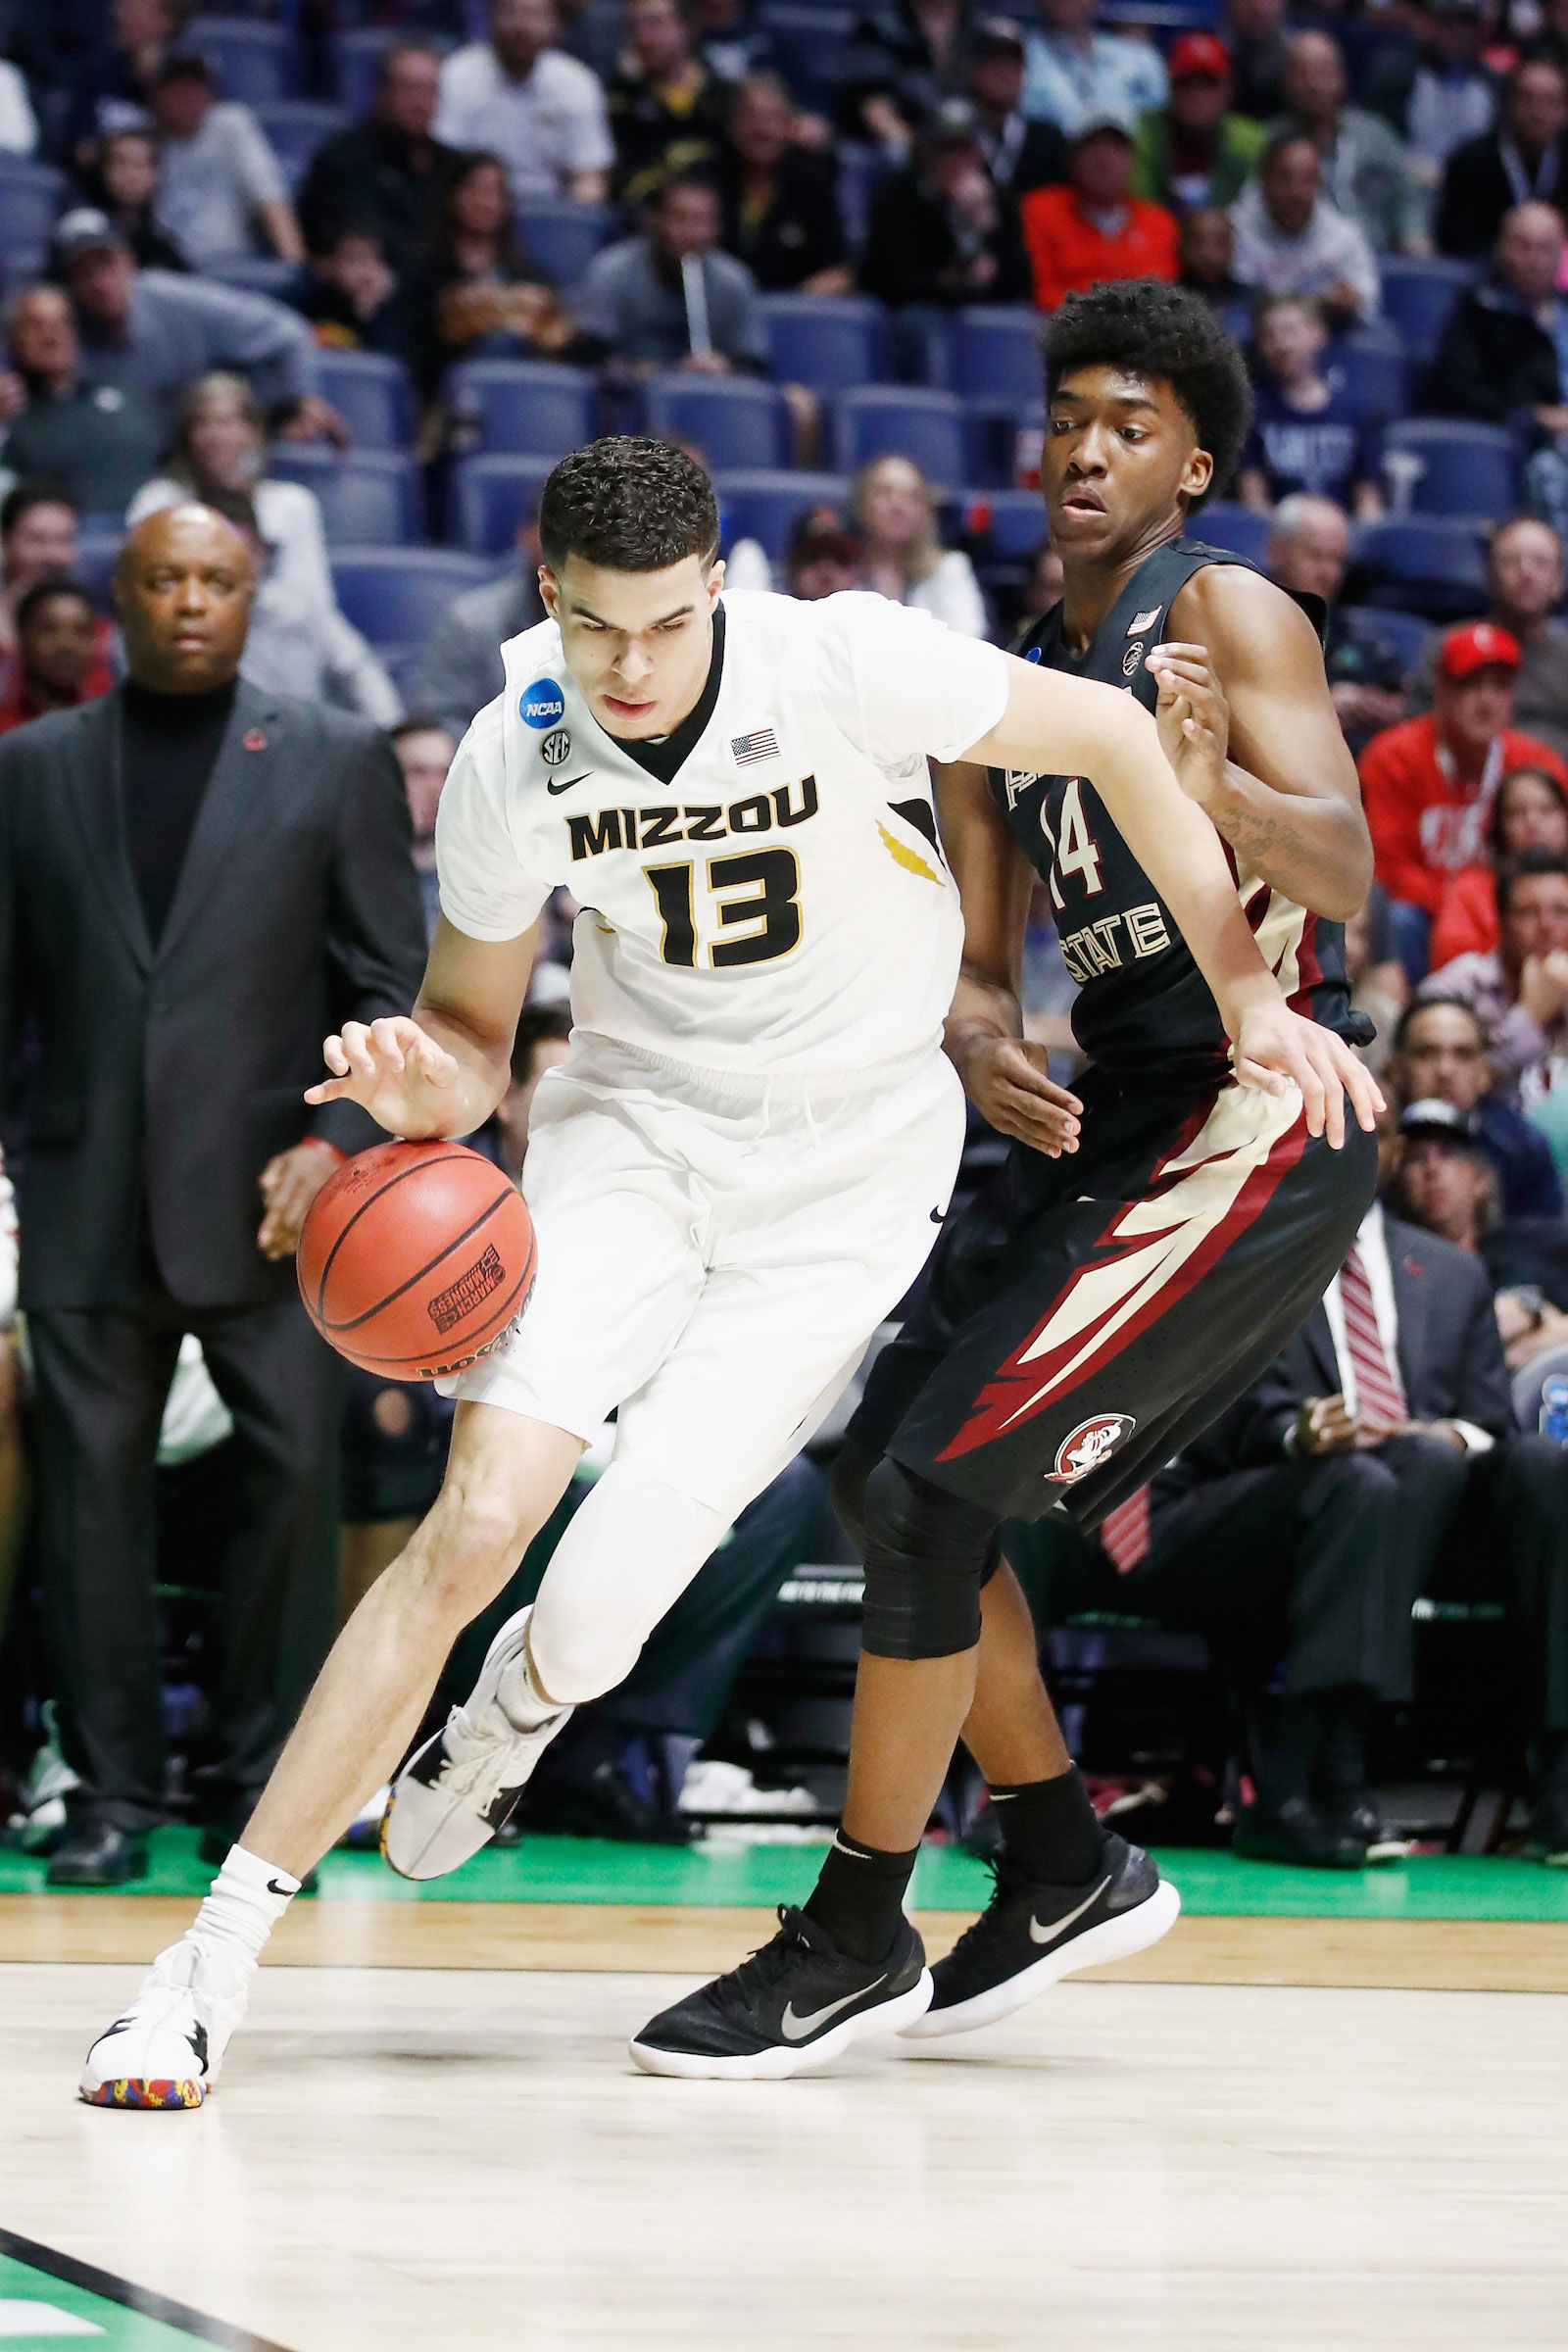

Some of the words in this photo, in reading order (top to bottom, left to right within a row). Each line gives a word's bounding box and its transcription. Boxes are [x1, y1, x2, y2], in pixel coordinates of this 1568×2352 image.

[526, 701, 564, 717] NCAA
[542, 731, 569, 764] SEC
[564, 771, 818, 861] MIZZOU
[1040, 775, 1104, 910] 14
[641, 845, 804, 968] 13
[1059, 903, 1171, 983] STATE
[429, 1264, 485, 1318] MADNESS
[455, 1266, 496, 1316] MARCH
